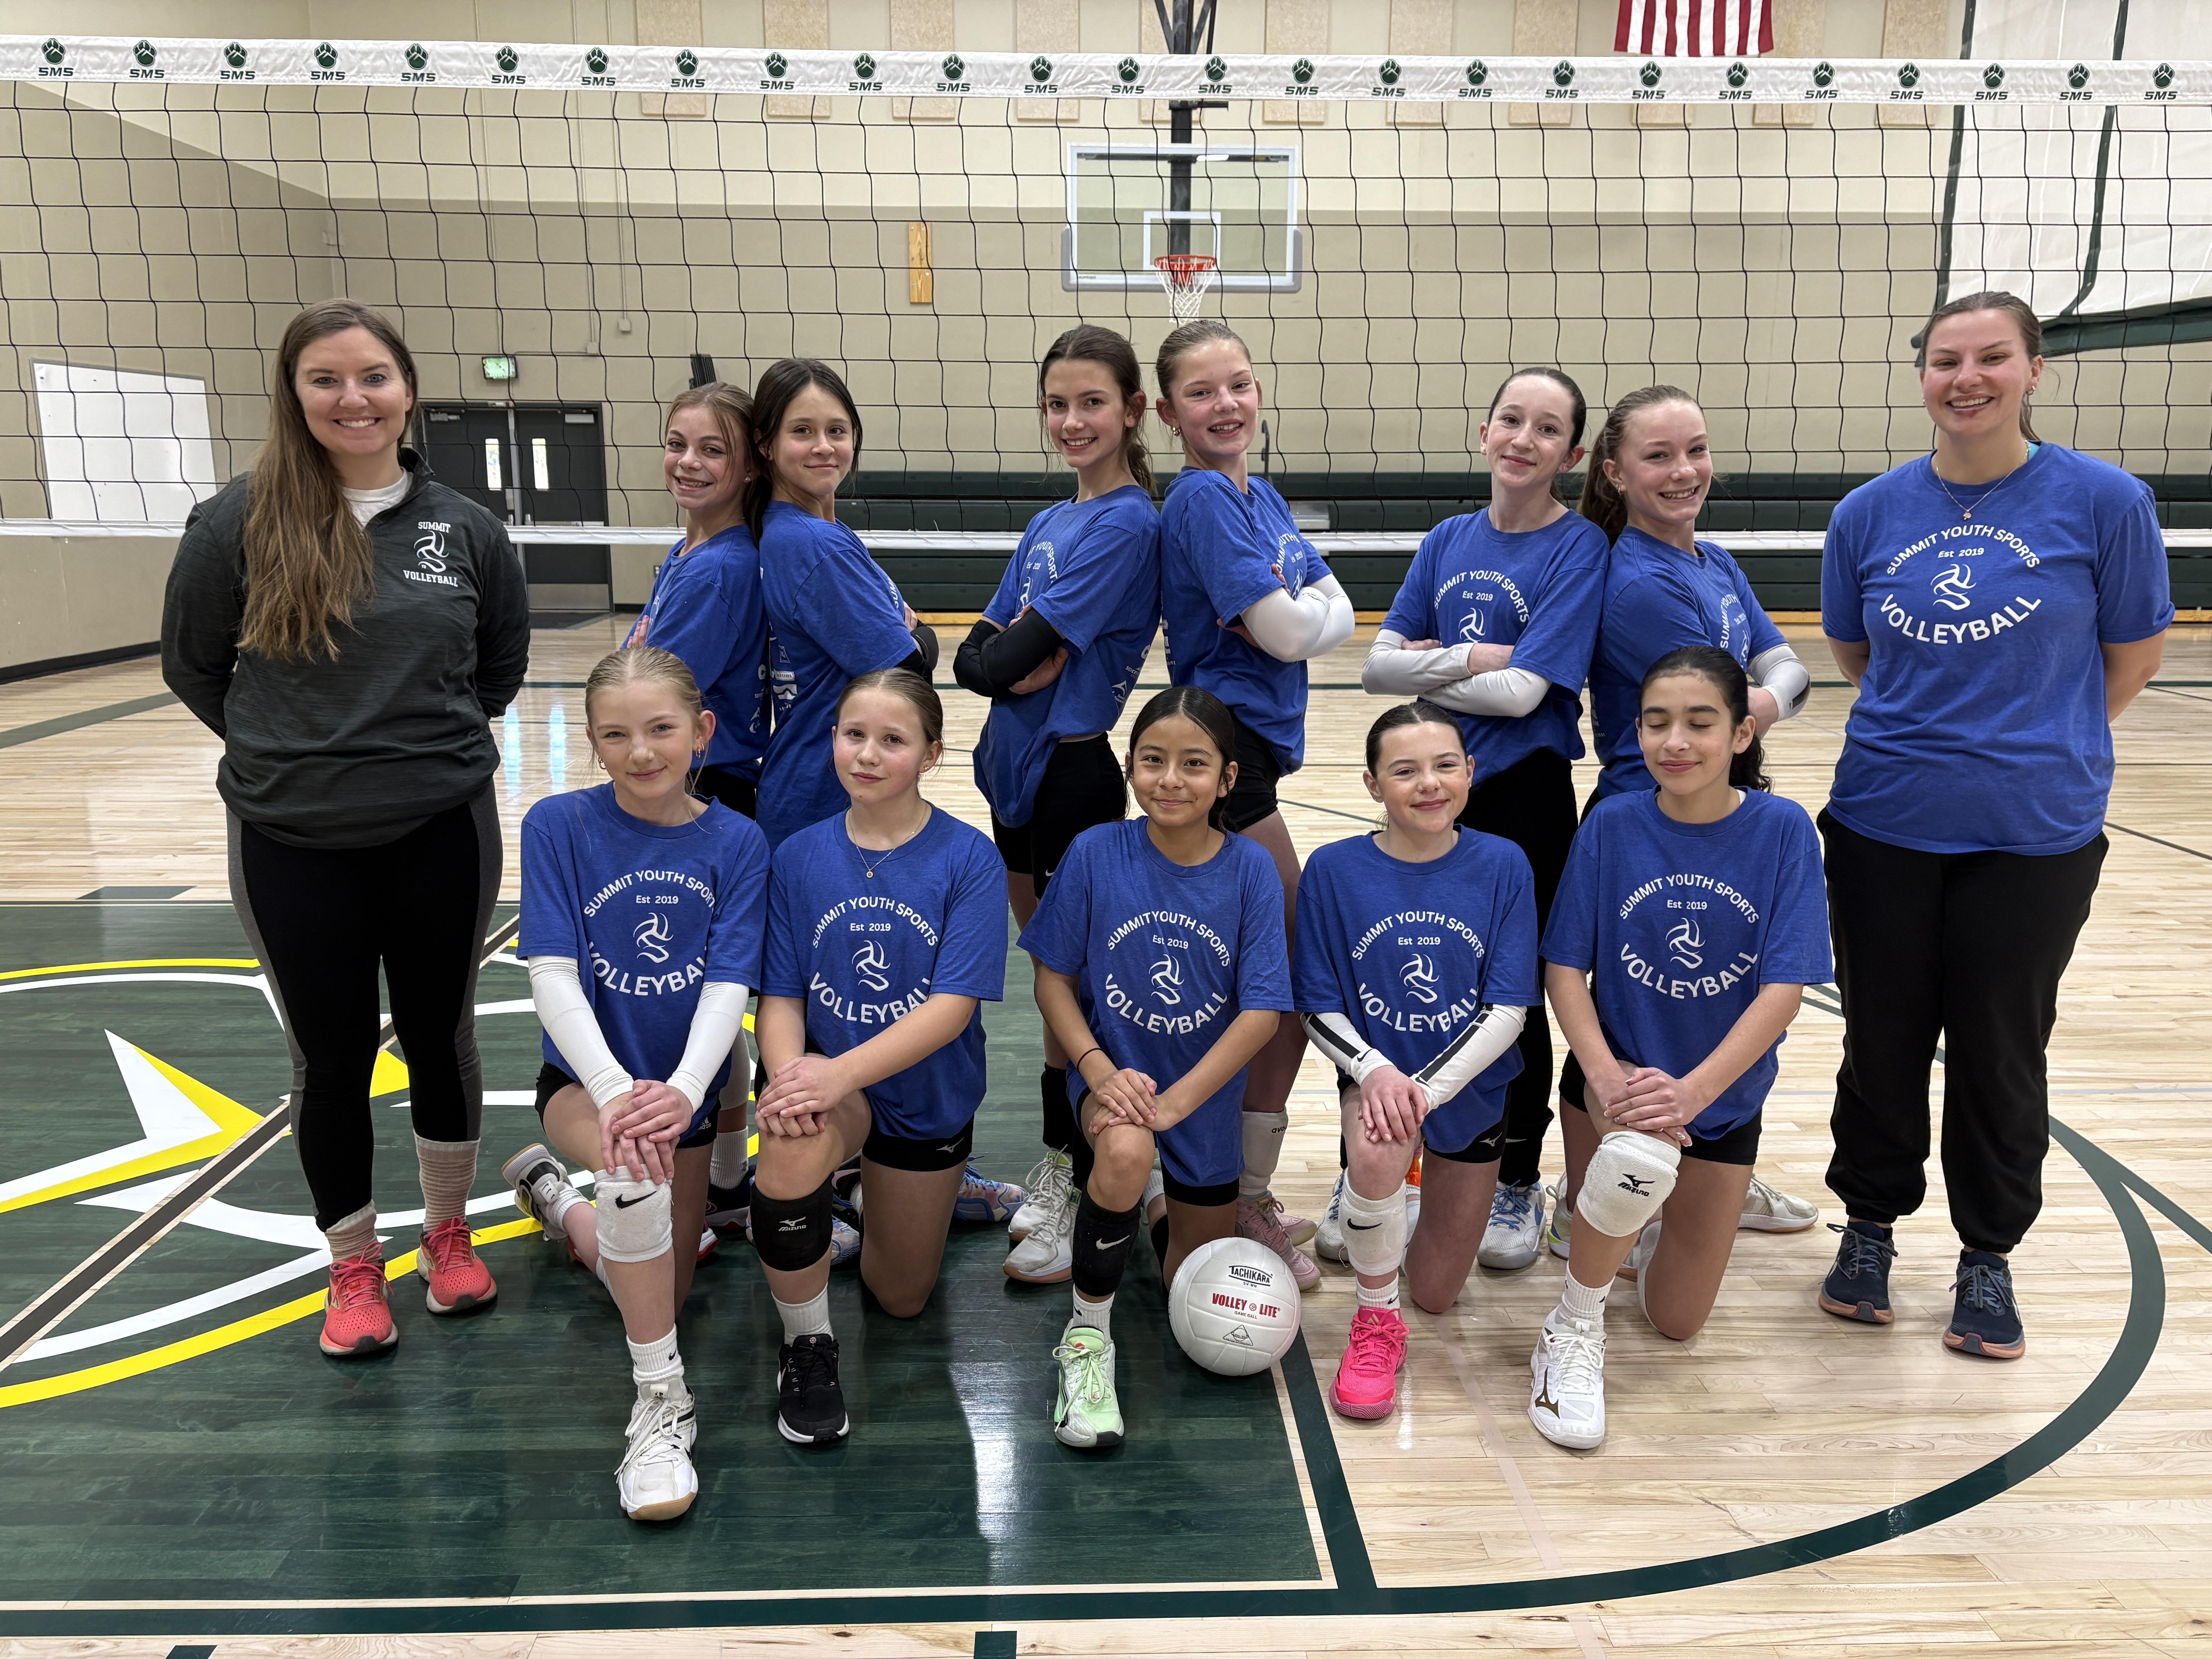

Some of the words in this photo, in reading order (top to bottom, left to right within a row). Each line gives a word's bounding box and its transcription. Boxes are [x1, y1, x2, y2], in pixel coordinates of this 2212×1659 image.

[38, 67, 74, 76] SMS
[129, 69, 165, 79] SMS
[220, 70, 256, 80] SMS
[310, 71, 345, 81] SMS
[400, 72, 436, 82] SMS
[491, 75, 526, 84] SMS
[581, 76, 616, 86] SMS
[670, 78, 705, 88] SMS
[759, 80, 795, 90] SMS
[848, 82, 883, 91] SMS
[936, 82, 971, 92] SMS
[1024, 84, 1058, 93] SMS
[1111, 84, 1145, 94] SMS
[1198, 84, 1232, 93] SMS
[1285, 86, 1319, 95] SMS
[1371, 87, 1406, 97] SMS
[1458, 88, 1492, 97] SMS
[1545, 89, 1579, 98] SMS
[1632, 90, 1666, 100] SMS
[1719, 91, 1752, 100] SMS
[1805, 89, 1838, 99] SMS
[1890, 91, 1923, 100] SMS
[1975, 91, 2008, 100] SMS
[2059, 91, 2093, 100] SMS
[2144, 91, 2178, 100] SMS
[417, 521, 451, 533] SUMMIT
[1887, 532, 1938, 576] SUMMIT
[1940, 524, 1995, 540] YOUTH
[1994, 529, 2040, 568] SPORTS
[1937, 550, 1955, 559] Est
[1958, 547, 1985, 557] 2019
[1047, 547, 1058, 583] SPORT
[403, 570, 458, 587] VOLLEYBALL
[1434, 572, 1467, 610] SUMMIT
[1470, 570, 1505, 584] YOUTH
[1501, 578, 1530, 623] SPORTS
[1462, 591, 1473, 599] Est
[1475, 592, 1493, 601] 2019
[1880, 593, 2042, 645] VOLLEYBALL
[584, 873, 633, 917] SUMMIT
[635, 870, 685, 884] YOUTH
[685, 877, 716, 913] SPORT
[635, 895, 651, 904] Est
[654, 895, 679, 904] 2019
[1620, 878, 1663, 920] SUMMIT
[1666, 874, 1715, 890] YOUTH
[1714, 882, 1760, 924] SPORTS
[1666, 899, 1683, 910] Est
[1686, 900, 1708, 910] 2019
[813, 901, 846, 949] SUMMIT
[848, 896, 895, 912] YOUTH
[895, 903, 939, 946] SPORTS
[850, 922, 865, 932] Est
[869, 922, 891, 932] 2019
[1108, 912, 1151, 951] SUMMIT
[1151, 910, 1197, 931] YOUTH
[1196, 923, 1231, 967] SPORTS
[1352, 916, 1393, 961] SUMMIT
[1395, 910, 1446, 926] YOUTH
[1446, 917, 1486, 959] SPORTS
[1152, 934, 1165, 945] Est
[1167, 938, 1189, 950] 2019
[1398, 937, 1413, 946] Est
[1417, 936, 1441, 946] 2019
[1620, 943, 1758, 1000] VOLLEYBALL
[1105, 973, 1228, 1036] VOLLEYBALL
[1228, 1265, 1273, 1284] TACHIKARA
[1212, 1293, 1248, 1311] VOLLEY
